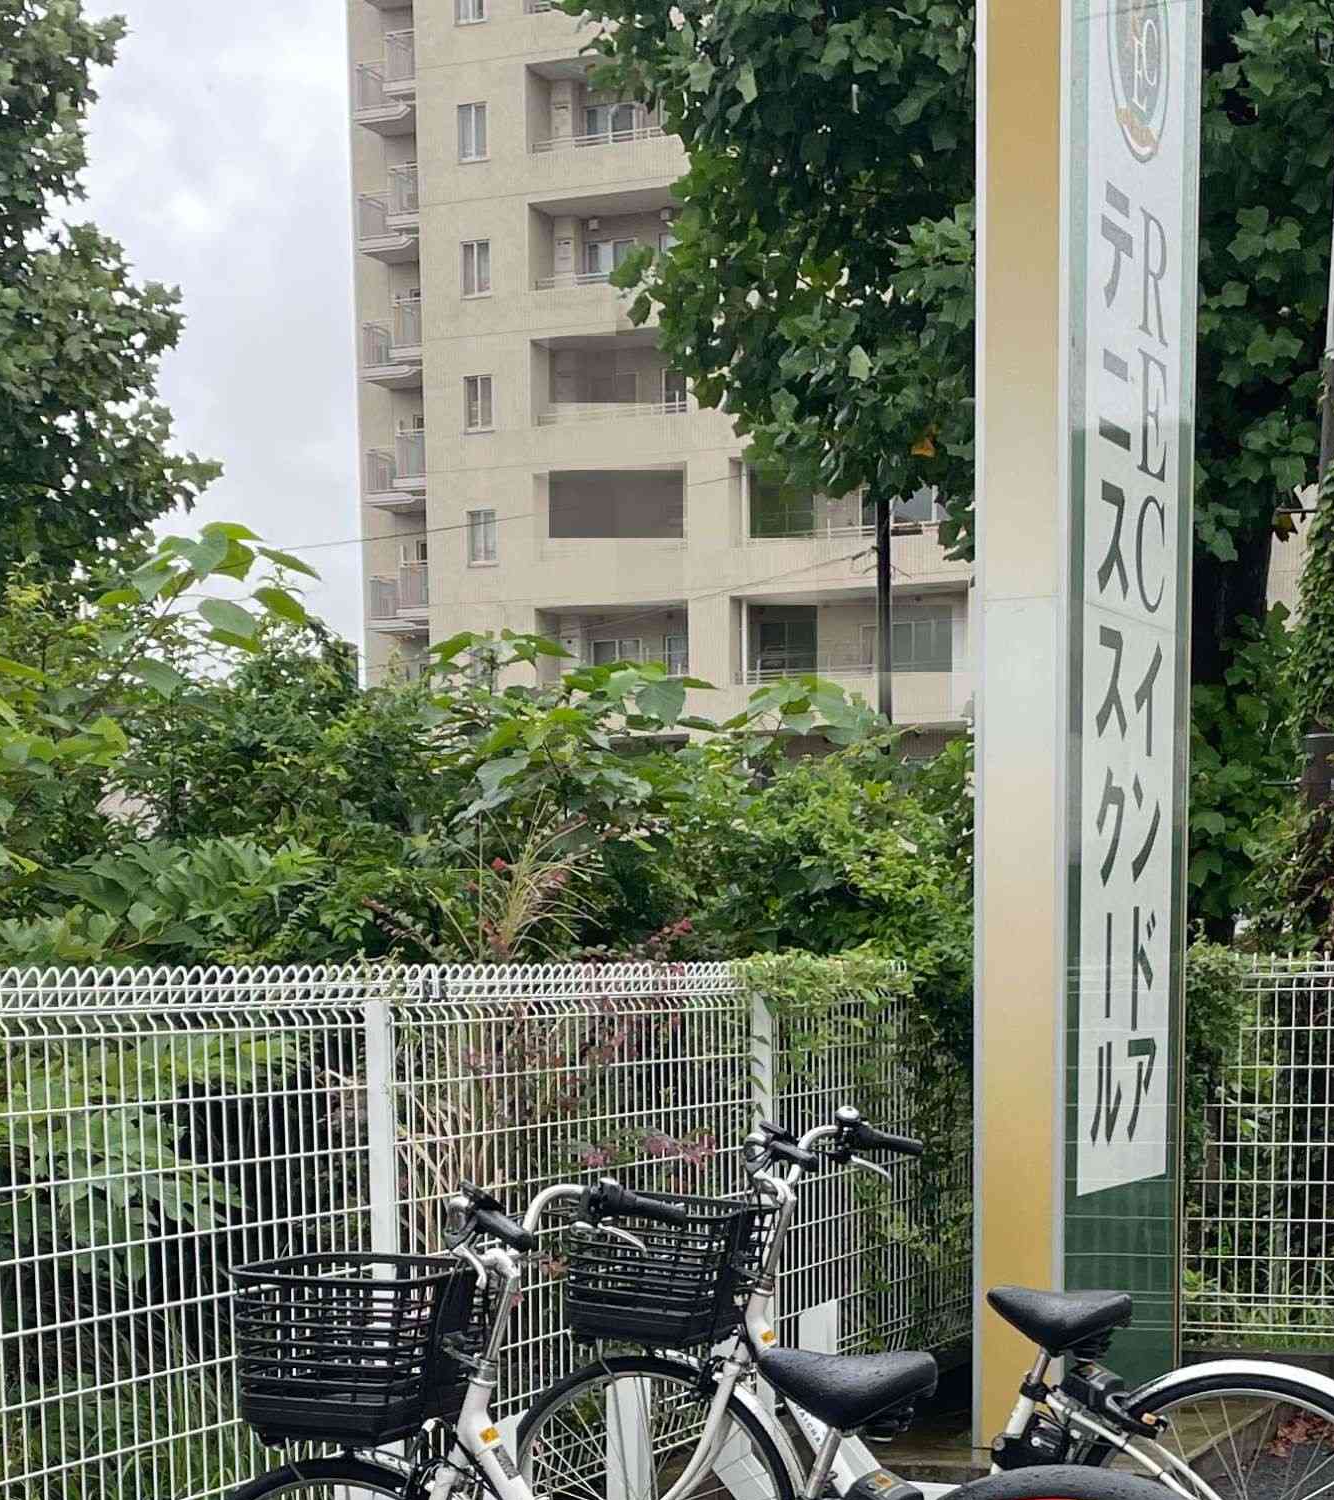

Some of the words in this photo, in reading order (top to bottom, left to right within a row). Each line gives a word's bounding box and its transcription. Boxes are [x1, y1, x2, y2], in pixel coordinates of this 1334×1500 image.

[1089, 179, 1135, 1149] テニススクール
